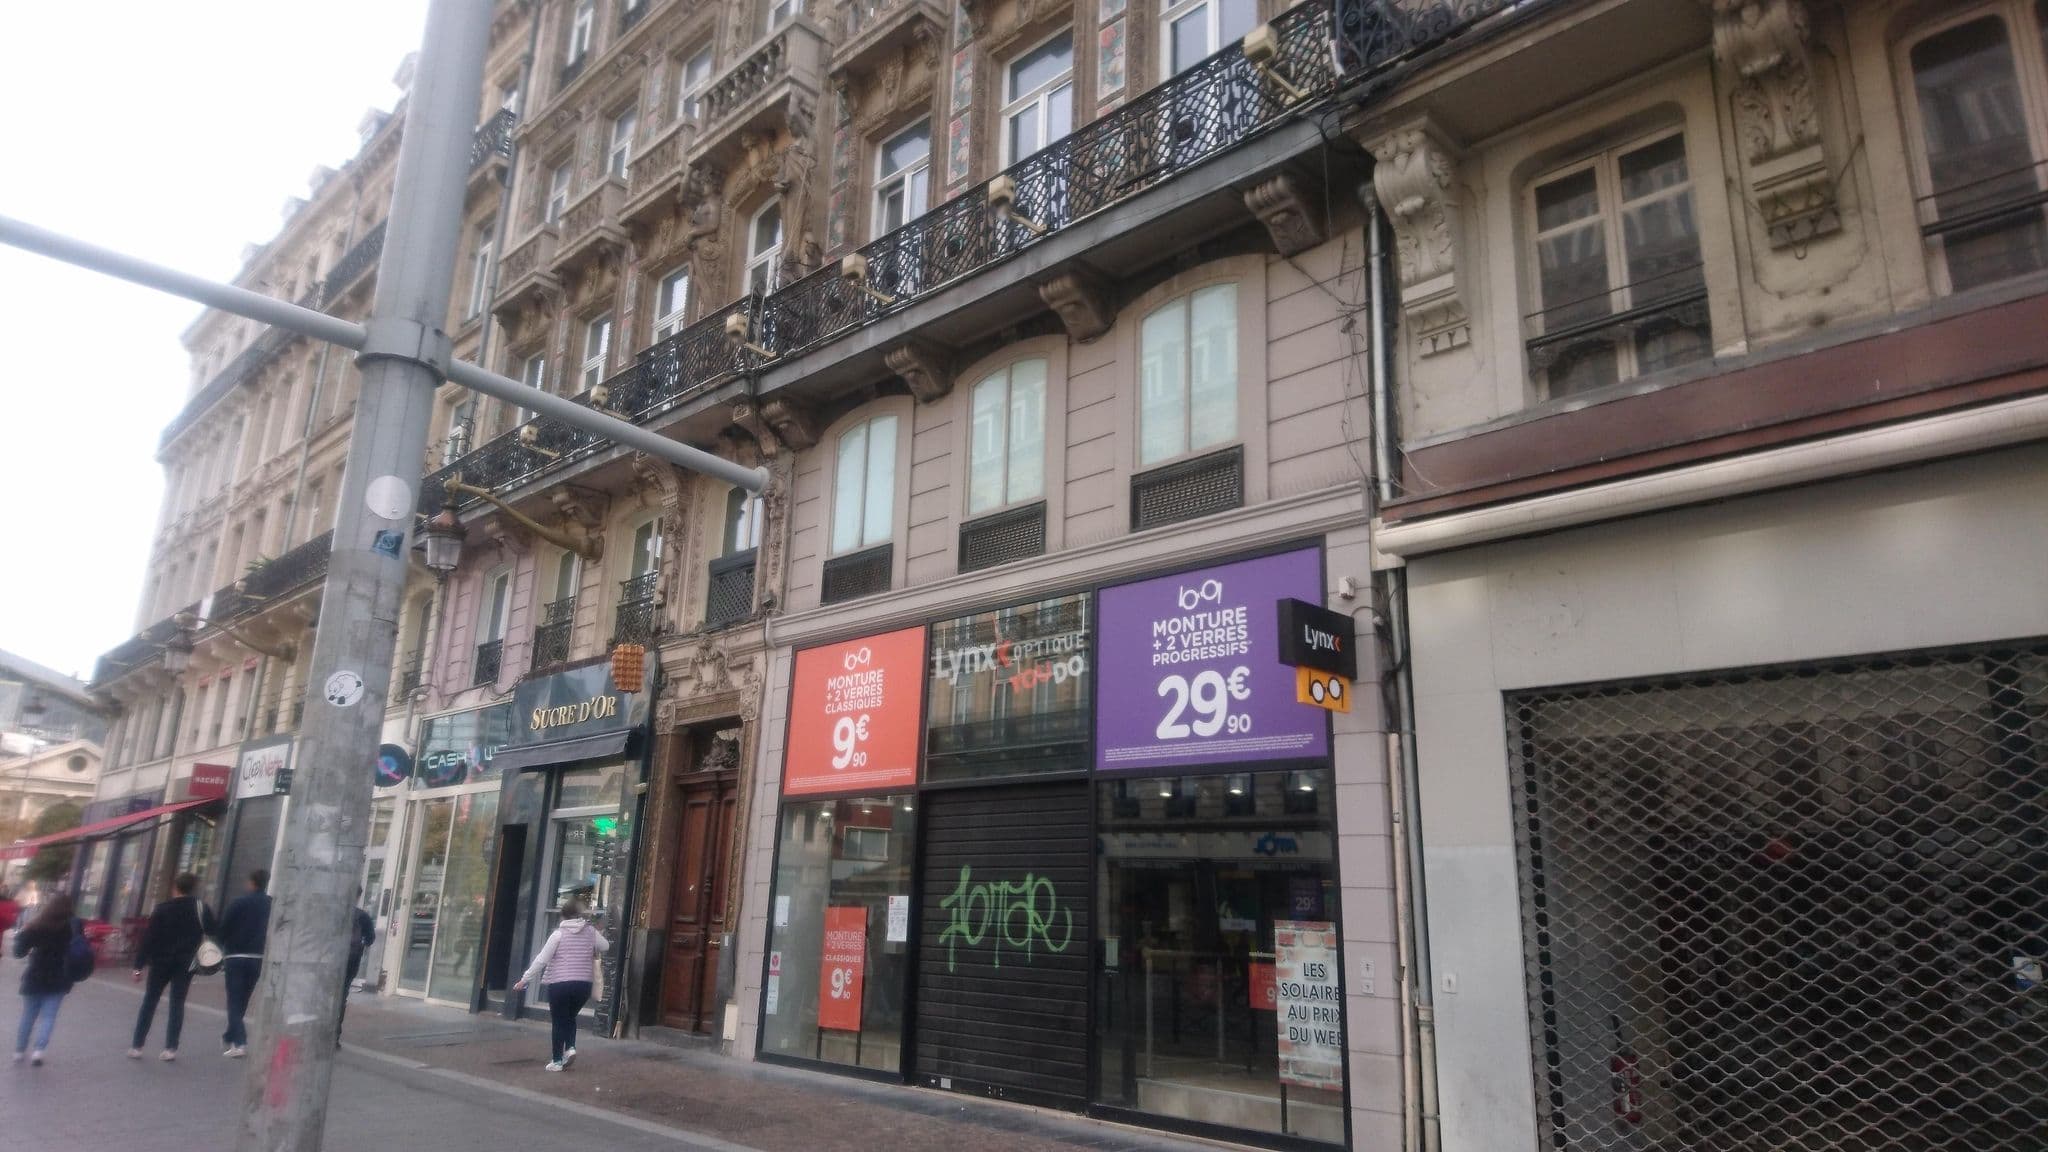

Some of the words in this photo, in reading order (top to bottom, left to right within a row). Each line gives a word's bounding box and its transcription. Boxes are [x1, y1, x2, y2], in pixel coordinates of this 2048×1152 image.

[1153, 606, 1247, 638] MONTURE
[1166, 635, 1176, 651] 2
[1180, 624, 1248, 649] VERRES
[1304, 624, 1335, 651] Lynx
[935, 642, 997, 686] Lynx
[1013, 632, 1085, 661] OPTIQUE
[1152, 641, 1249, 666] PROGRESSIFS
[827, 669, 885, 692] MONTURE
[835, 690, 841, 702] 2
[843, 683, 883, 700] VERRES
[530, 704, 577, 731] SUCRE
[577, 695, 617, 723] D'OR
[825, 696, 883, 714] CLASSIQUES
[1227, 713, 1251, 734] 90
[427, 752, 468, 770] CASH
[852, 751, 867, 767] 90
[826, 930, 863, 943] MONTURE
[1303, 962, 1326, 978] LES
[1287, 1004, 1307, 1020] AU
[1289, 1027, 1309, 1042] DU
